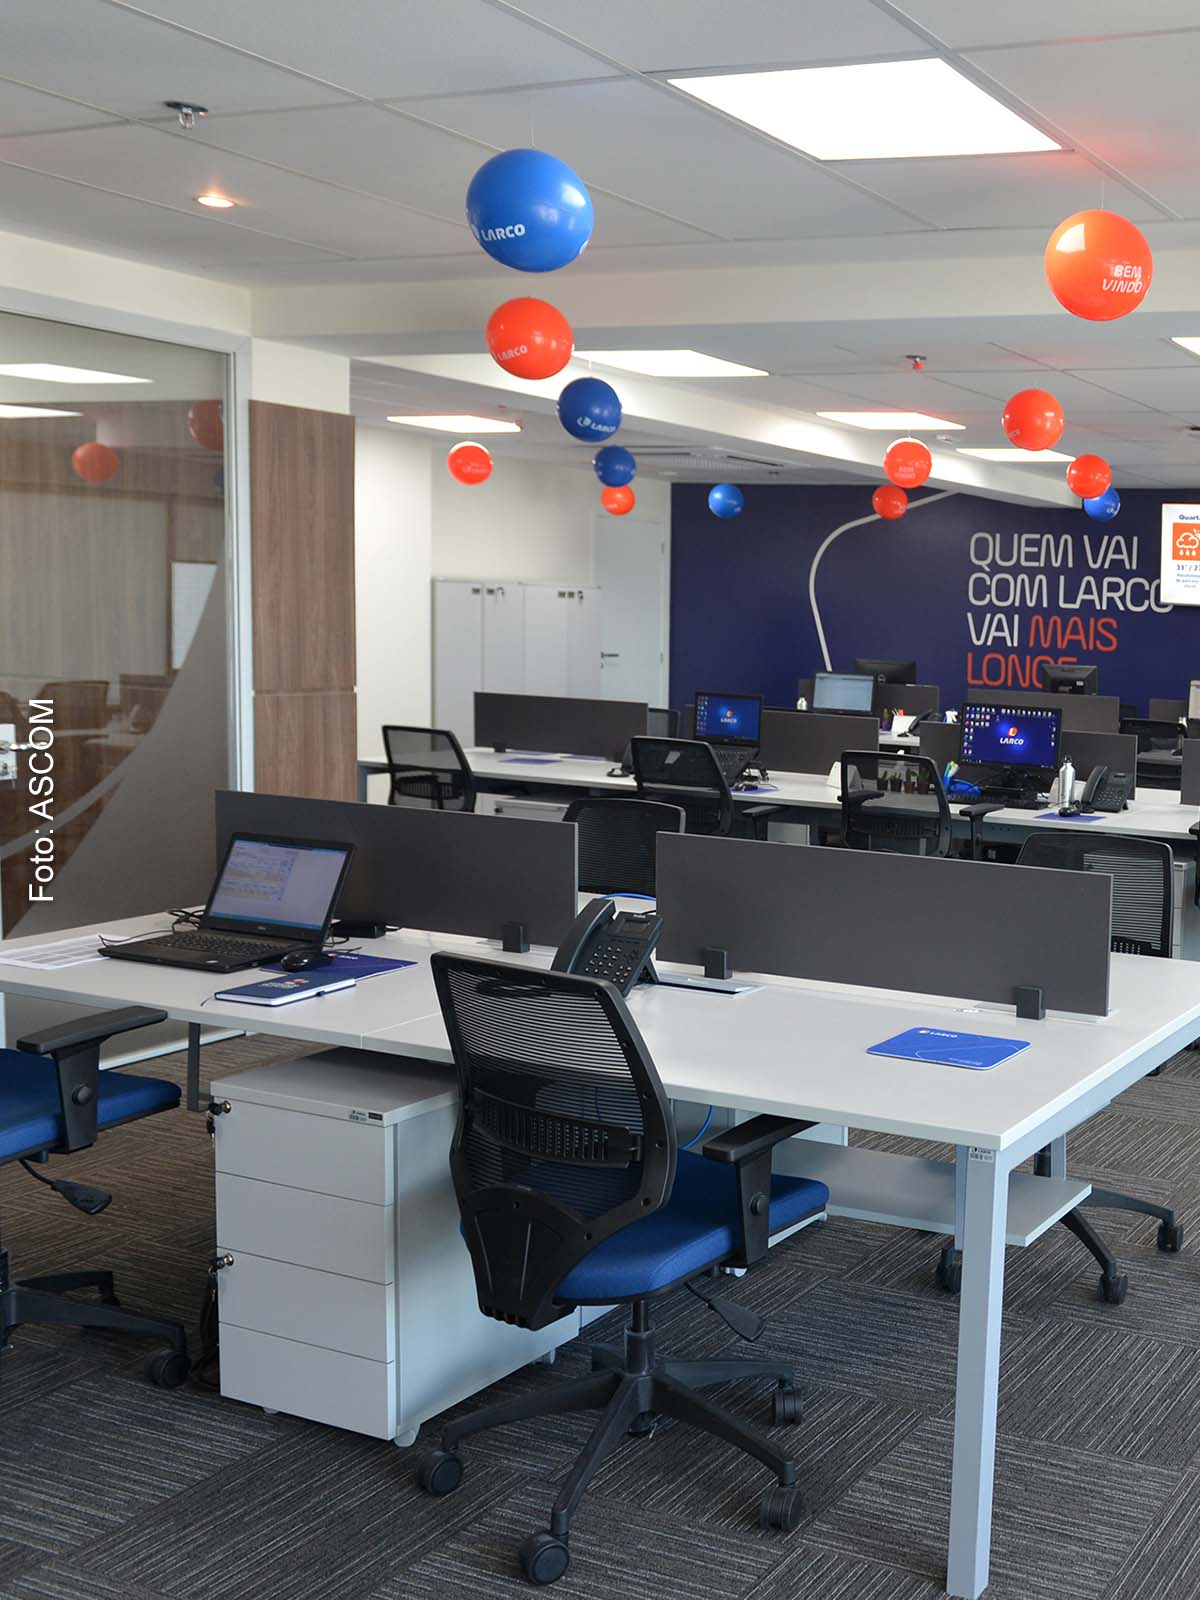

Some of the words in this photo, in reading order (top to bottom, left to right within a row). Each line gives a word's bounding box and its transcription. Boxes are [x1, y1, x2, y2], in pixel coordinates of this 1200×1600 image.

[481, 223, 525, 241] LARCO
[1113, 264, 1142, 279] BEM
[1101, 278, 1143, 294] VINDO
[498, 345, 528, 361] LARCO
[591, 421, 617, 433] LARCO
[969, 532, 1074, 571] QUEM
[1083, 535, 1138, 570] VAI
[968, 572, 1048, 608] COM
[1058, 575, 1174, 613] LARCO
[967, 612, 1019, 647] VAI
[1029, 614, 1118, 652] MAIS
[967, 652, 1077, 689] LONG
[1000, 737, 1024, 745] LARCO
